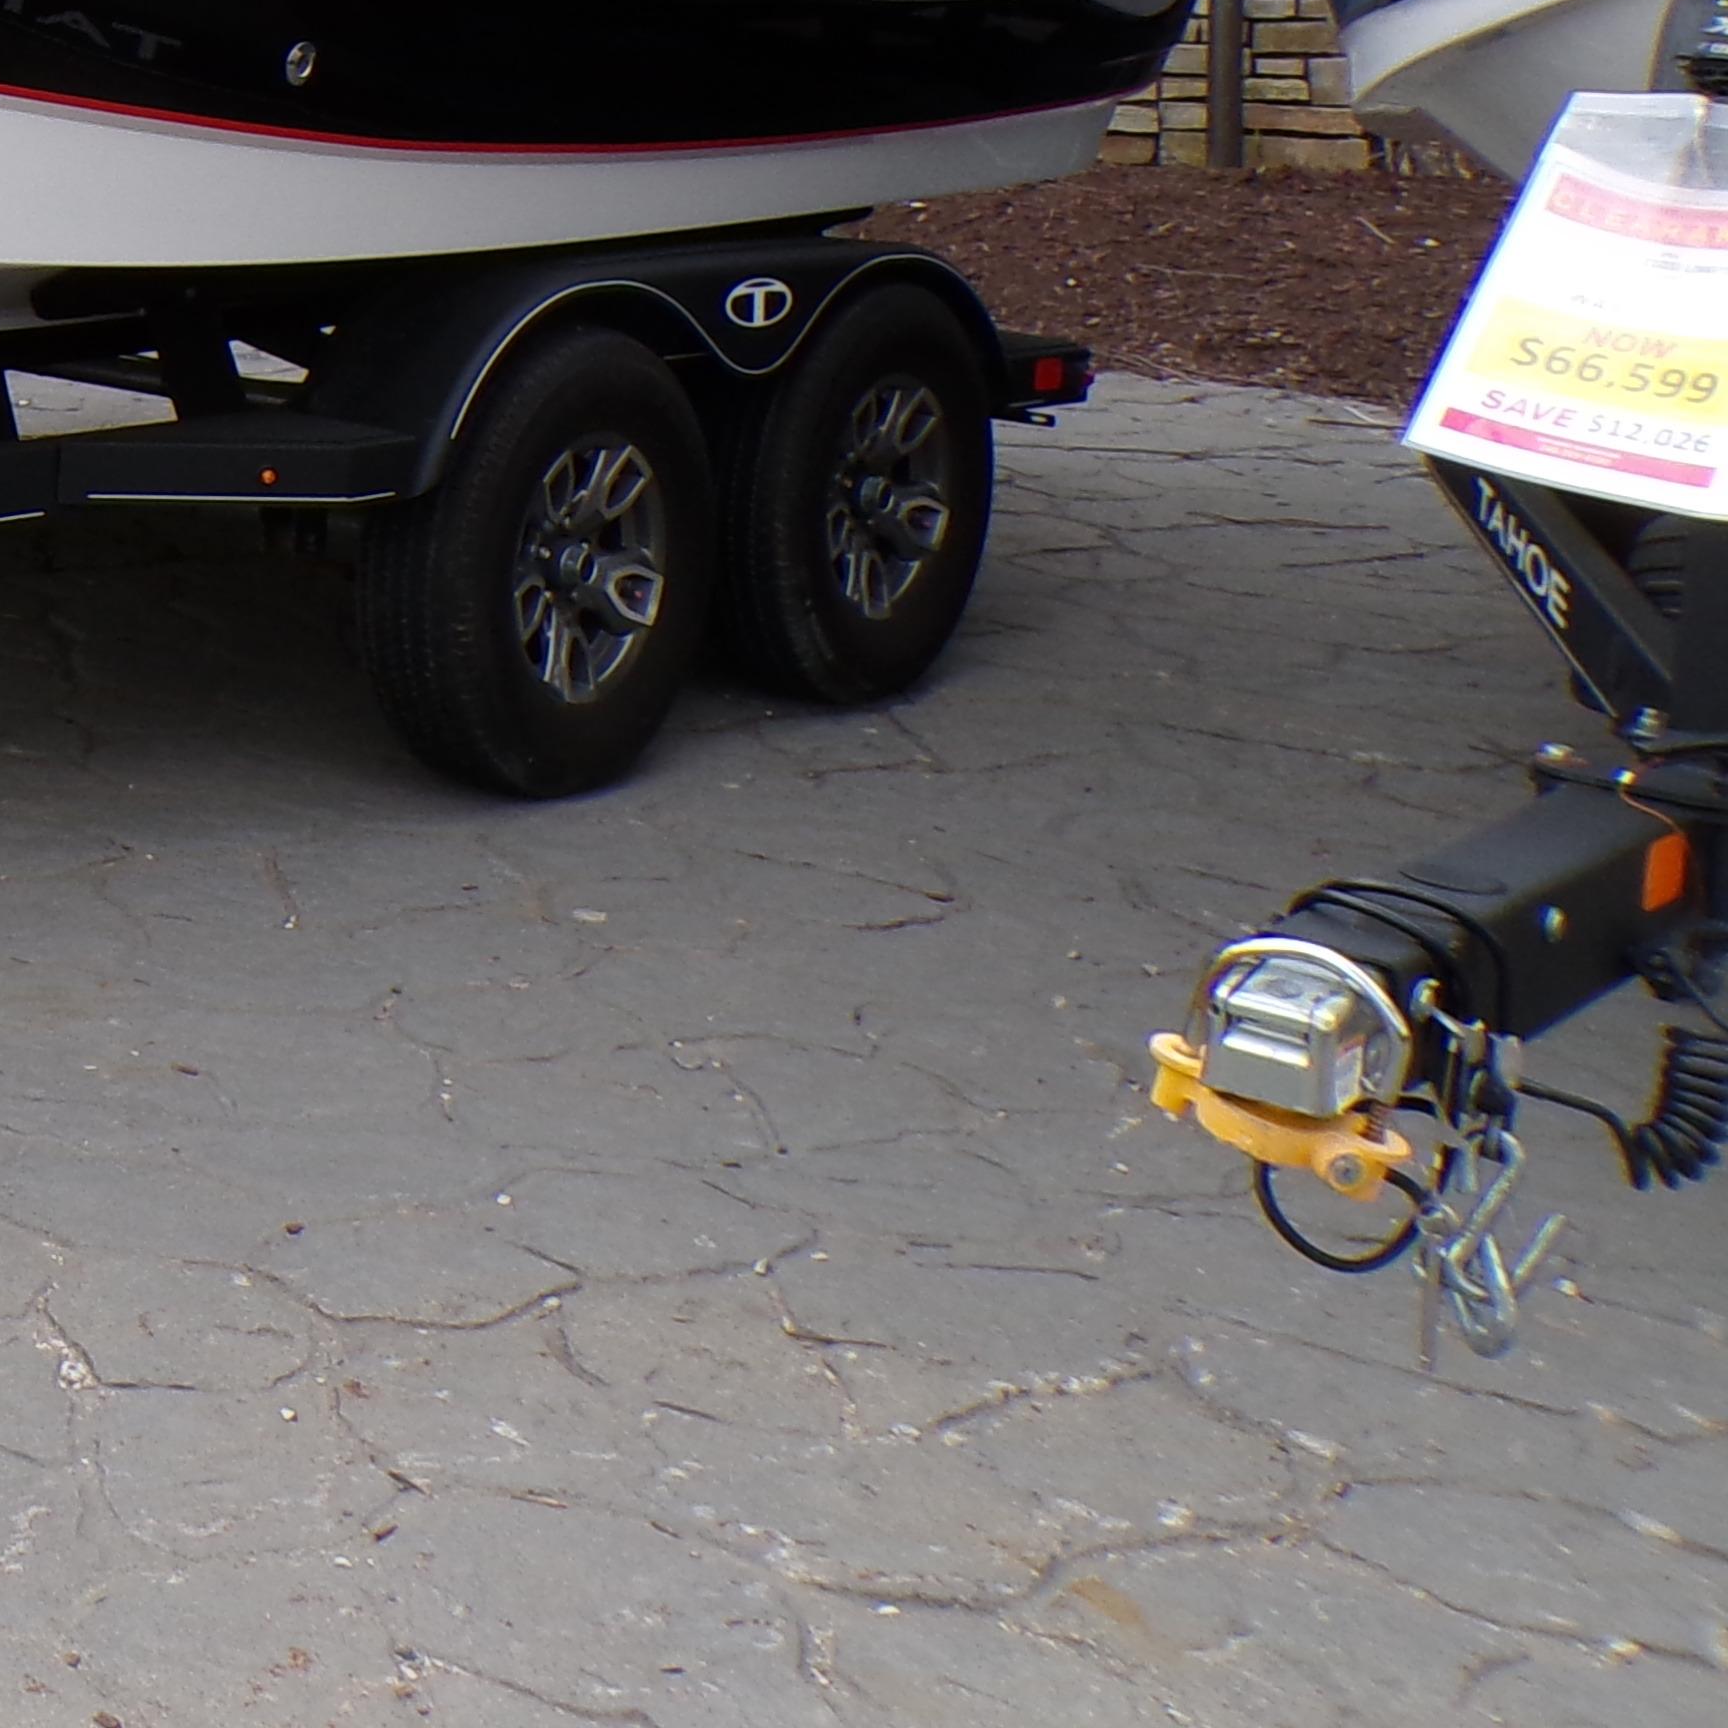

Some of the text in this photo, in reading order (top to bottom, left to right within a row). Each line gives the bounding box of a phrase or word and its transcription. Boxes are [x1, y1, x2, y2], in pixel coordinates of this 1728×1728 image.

[1582, 326, 1679, 360] NOW
[1480, 388, 1578, 429] SAVE
[1475, 475, 1572, 630] TAHOE
